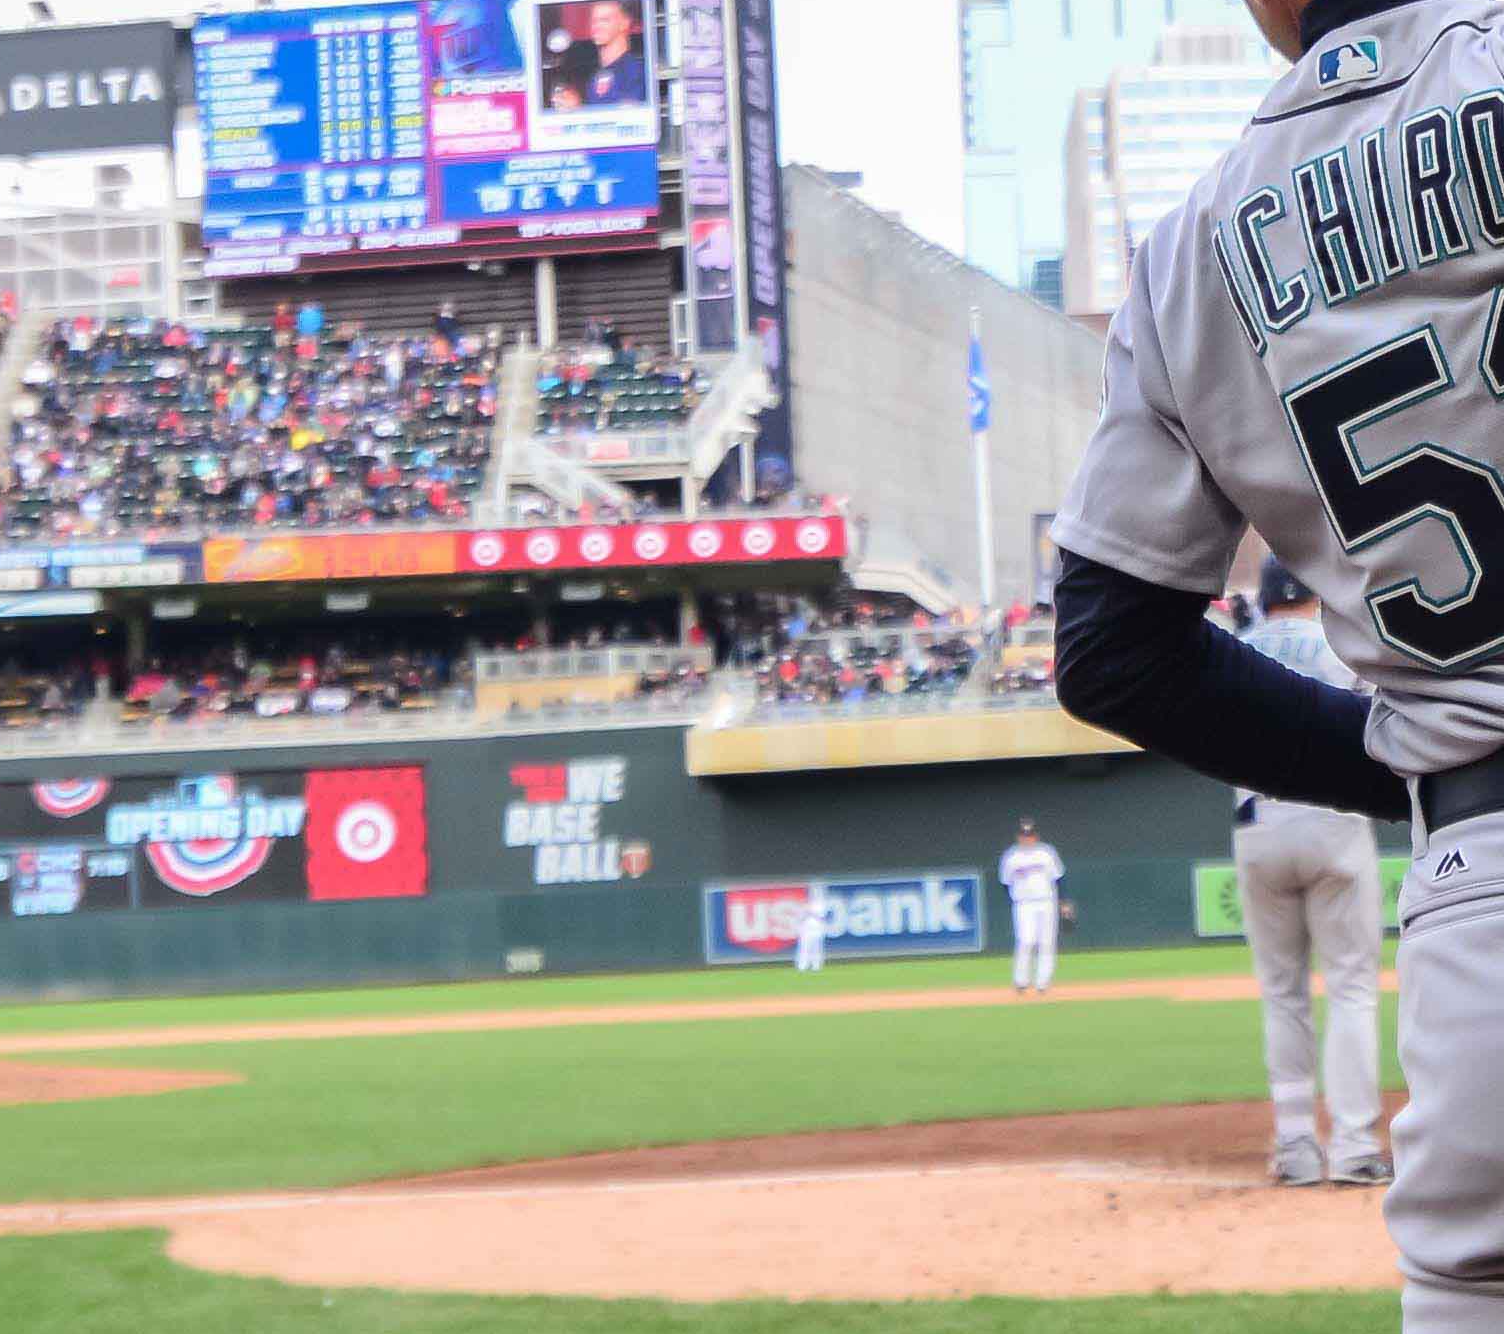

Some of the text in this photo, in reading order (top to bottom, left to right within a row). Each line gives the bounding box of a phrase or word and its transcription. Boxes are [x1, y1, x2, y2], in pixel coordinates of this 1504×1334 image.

[9, 68, 164, 111] DELTA
[567, 756, 626, 805] WE
[106, 796, 306, 845] OPENING DAY
[505, 802, 602, 848] BASE
[534, 836, 623, 885] BALL
